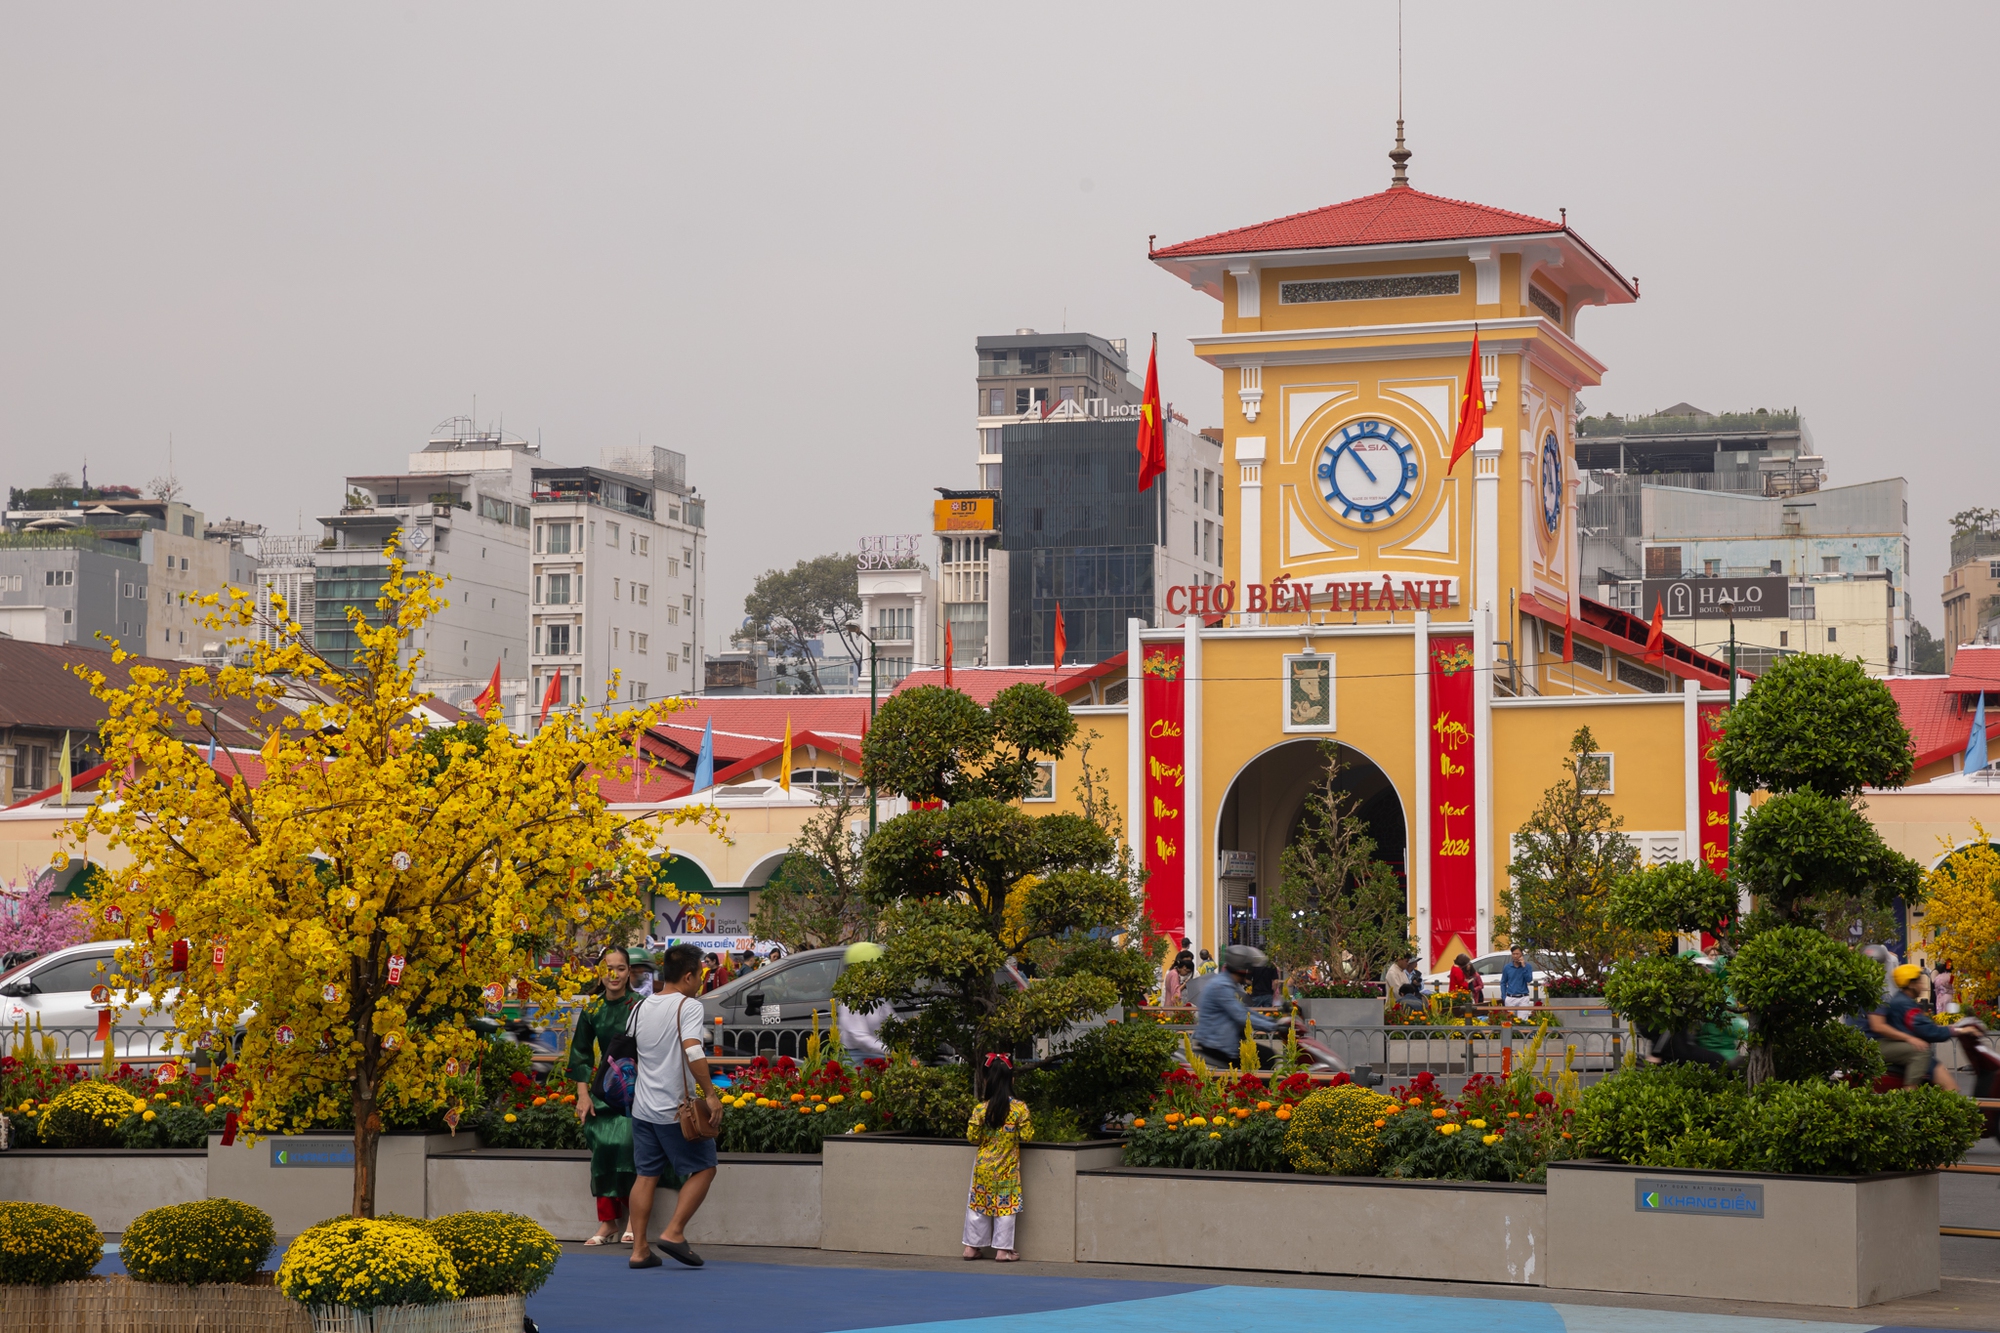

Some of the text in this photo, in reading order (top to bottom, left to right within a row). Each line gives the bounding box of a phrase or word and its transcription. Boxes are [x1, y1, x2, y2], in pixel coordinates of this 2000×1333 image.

[1020, 397, 1142, 421] AVANTI HOTE
[1357, 420, 1380, 437] 12
[1317, 463, 1331, 479] 9
[1404, 463, 1419, 479] 3
[961, 501, 977, 511] BTJ
[1360, 507, 1374, 523] 6
[856, 553, 892, 570] SPA
[1166, 573, 1451, 615] CHỢ BẾN THÀNH
[1699, 586, 1763, 604] HALO
[1433, 710, 1475, 750] Happy
[1439, 838, 1470, 856] 2026
[718, 926, 742, 934] Bank
[762, 1016, 781, 1025] 1900
[1664, 1192, 1757, 1211] KHANG ĐIỀN
